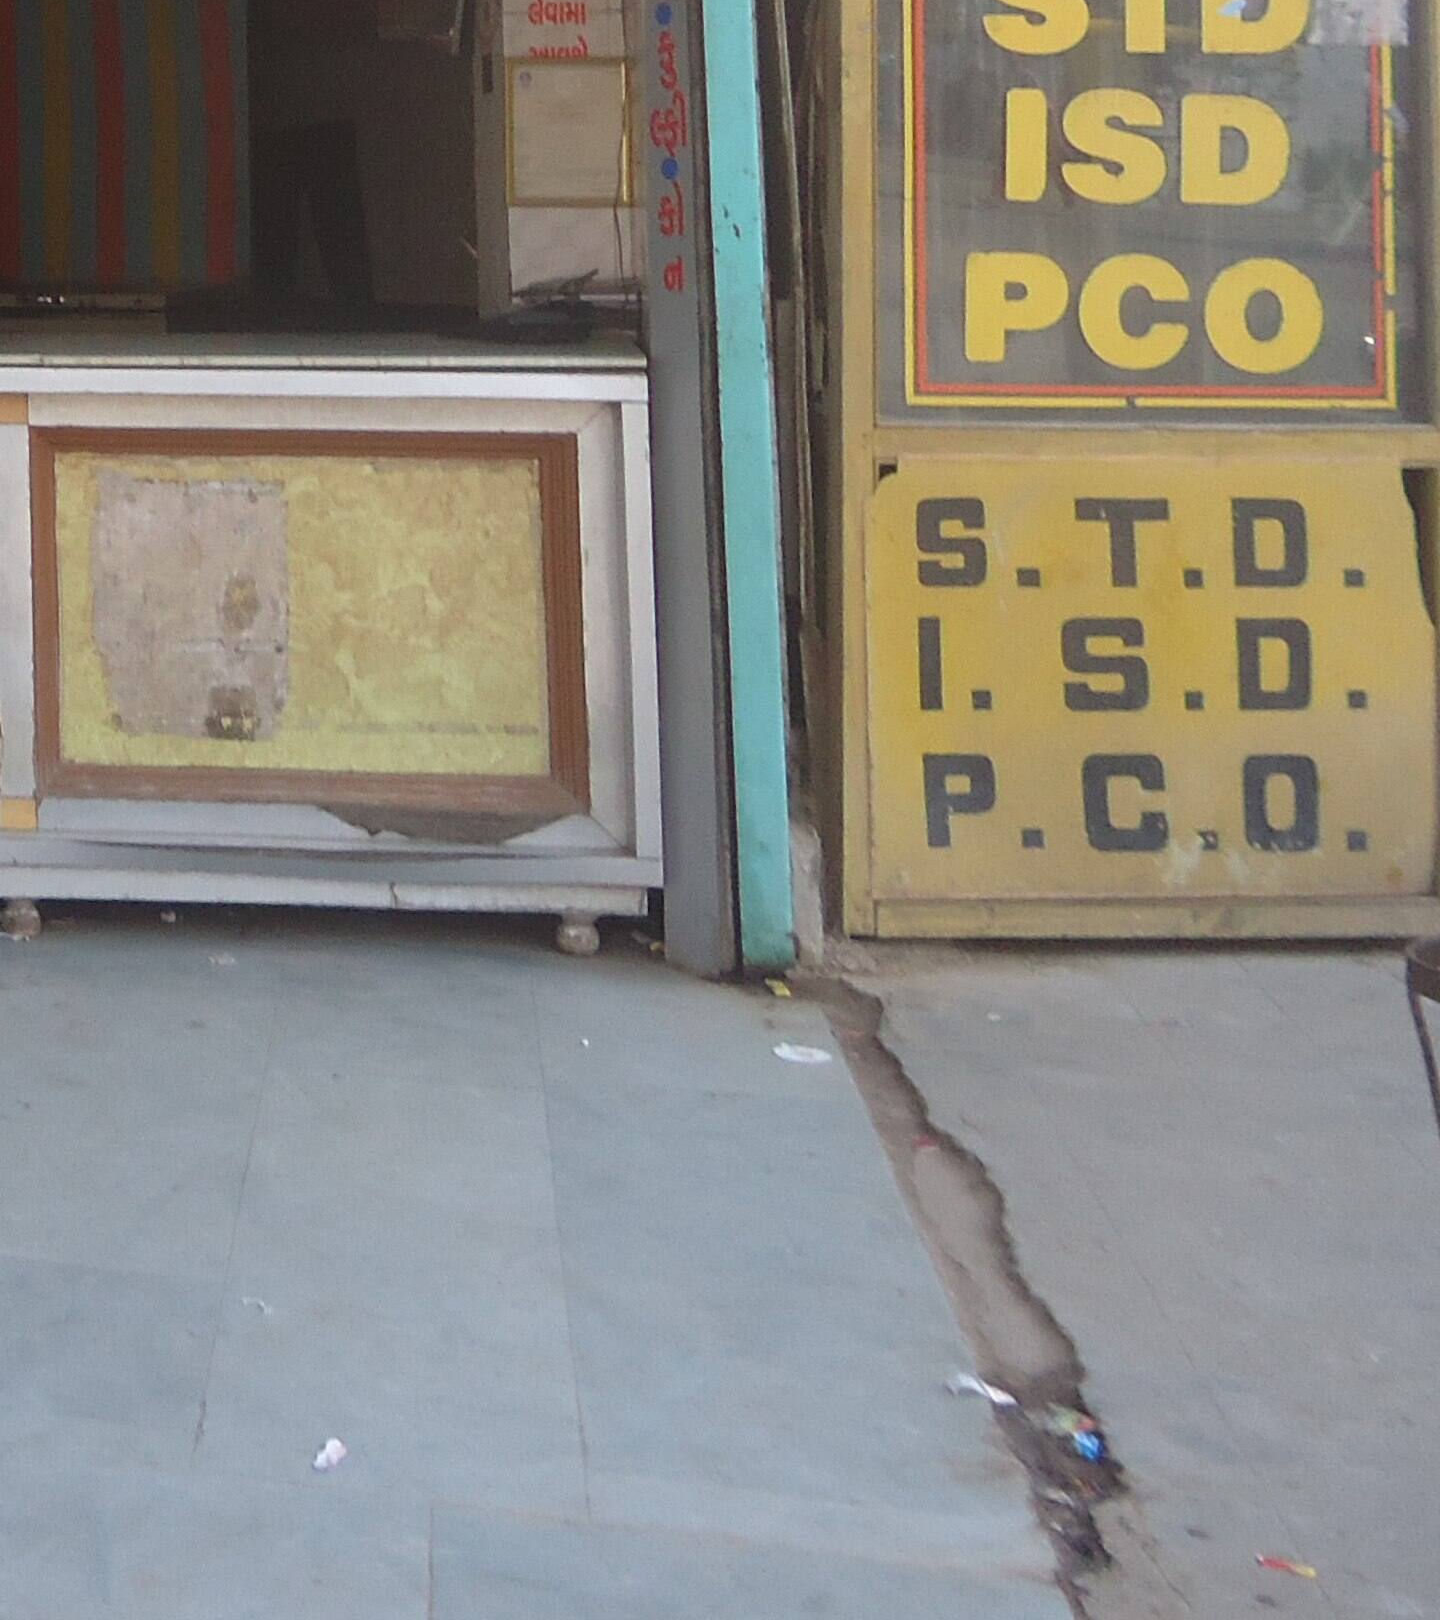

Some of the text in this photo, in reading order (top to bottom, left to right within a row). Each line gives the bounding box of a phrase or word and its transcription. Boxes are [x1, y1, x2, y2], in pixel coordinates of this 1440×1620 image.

[1006, 88, 1291, 204] ISD
[965, 252, 1323, 373] PCO
[916, 497, 1366, 587] S.T.D.
[918, 617, 1368, 711] I.S.D.
[922, 754, 1368, 852] P.C.O.
